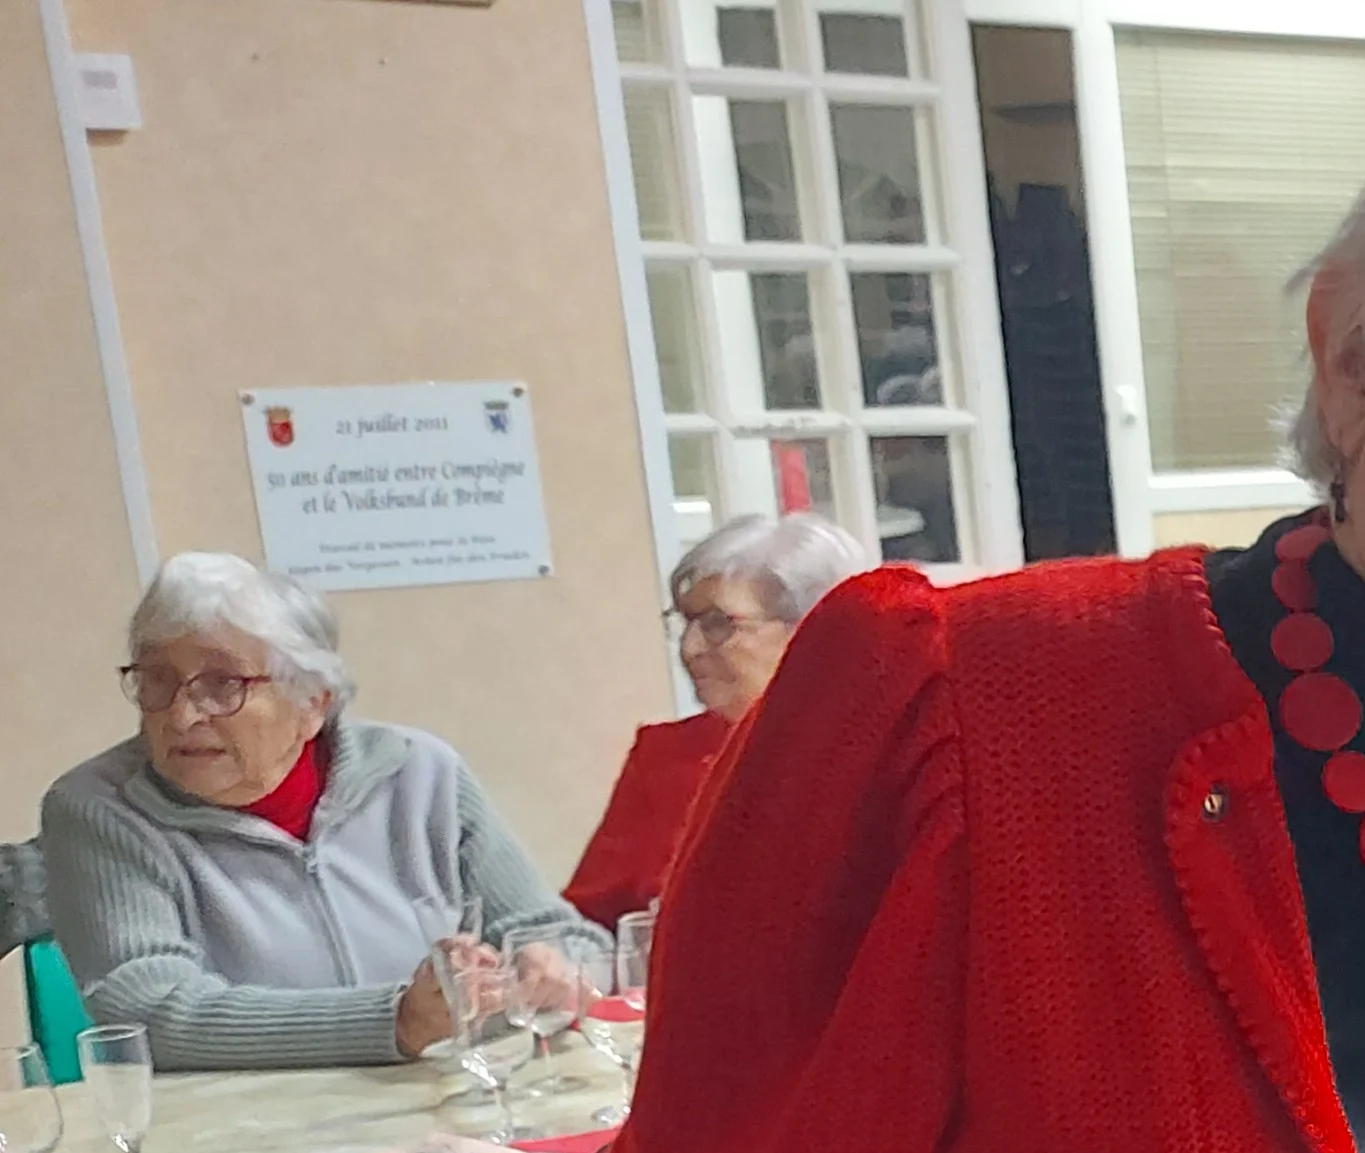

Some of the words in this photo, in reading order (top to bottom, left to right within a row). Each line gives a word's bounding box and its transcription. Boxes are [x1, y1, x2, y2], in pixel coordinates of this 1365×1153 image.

[290, 471, 318, 487] ans
[394, 464, 436, 482] entre
[302, 496, 317, 514] et
